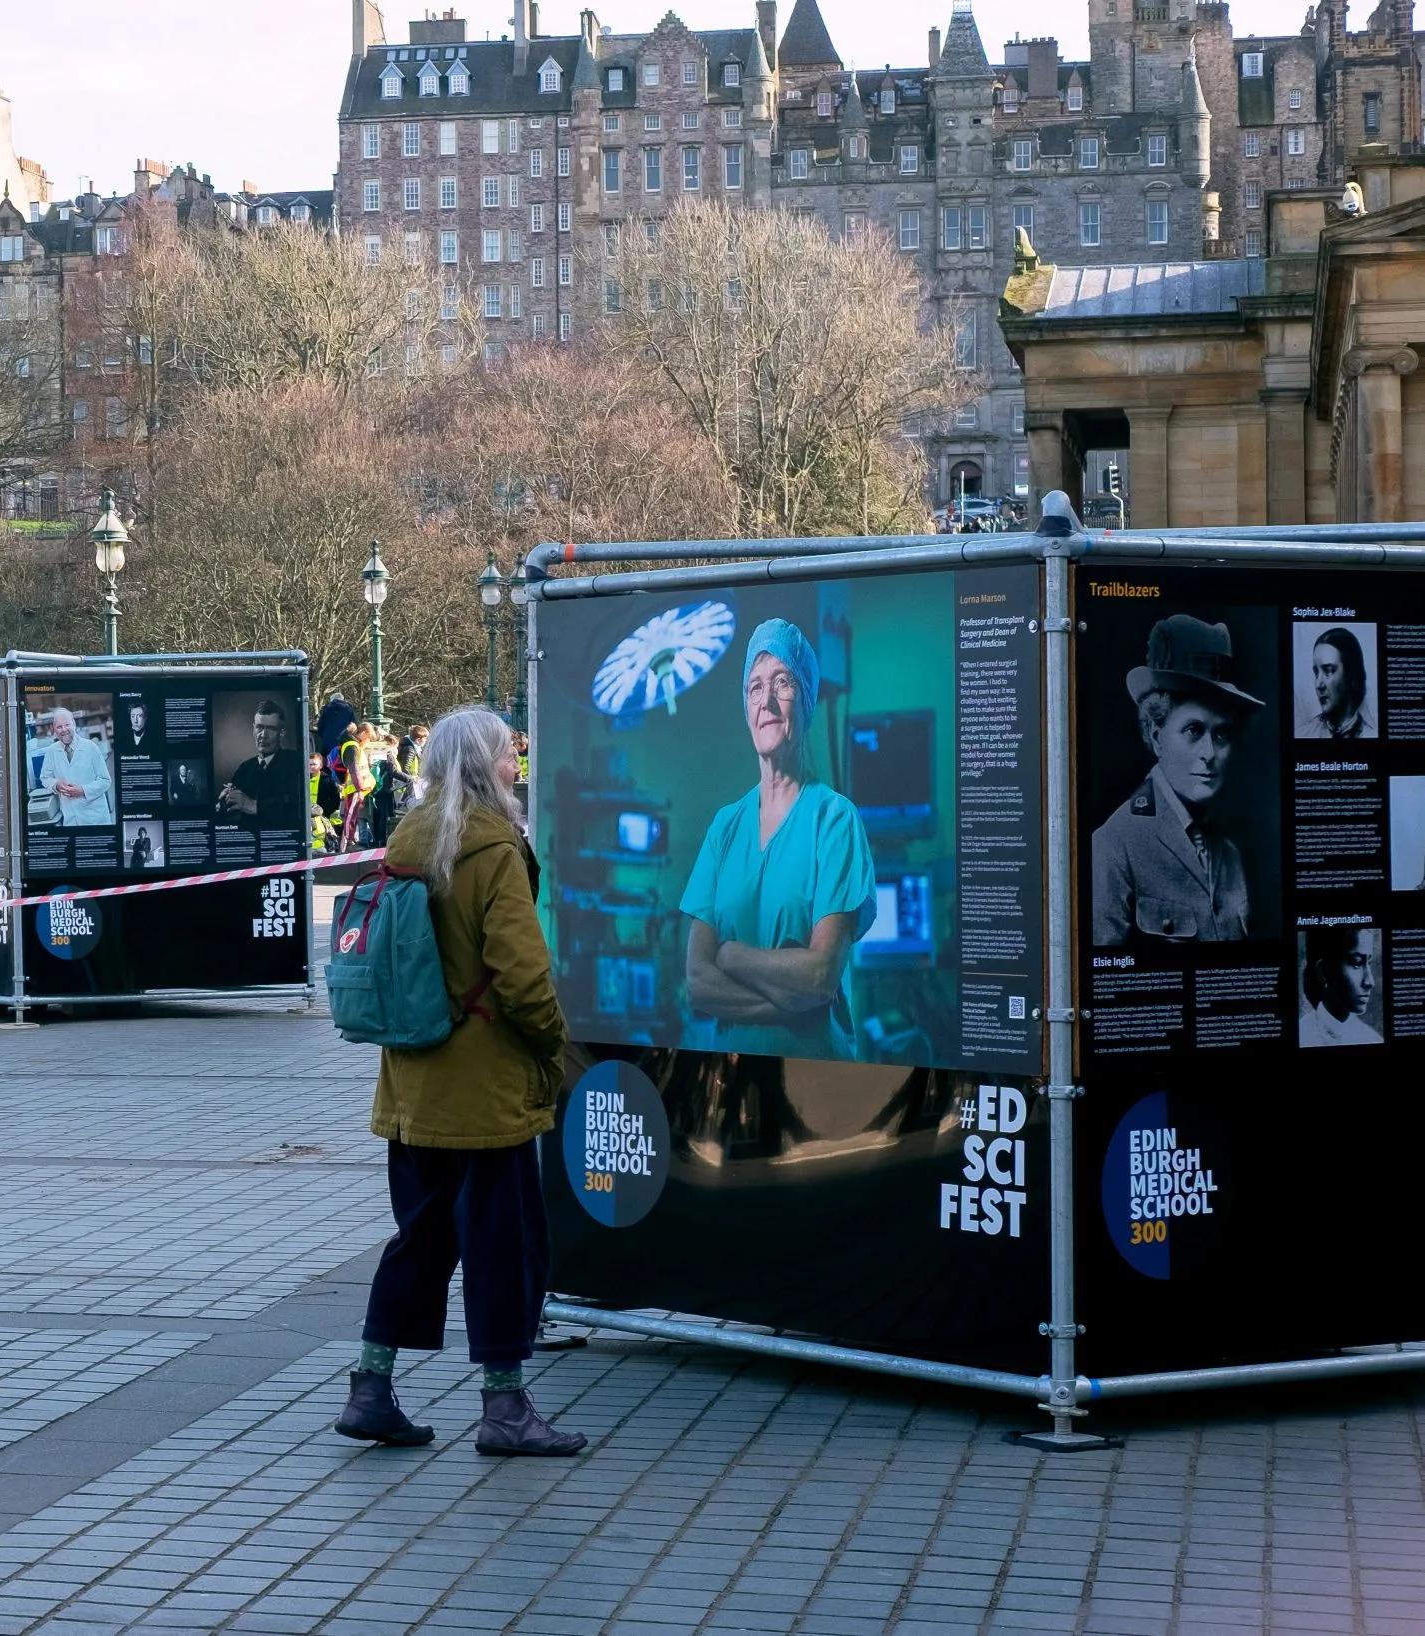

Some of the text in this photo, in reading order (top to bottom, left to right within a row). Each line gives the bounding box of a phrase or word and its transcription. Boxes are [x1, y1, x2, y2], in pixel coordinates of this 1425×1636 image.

[960, 594, 1006, 604] Lorna Marson
[1089, 582, 1159, 597] Trailblazers
[960, 616, 1024, 626] Professor of Transplant
[1293, 607, 1355, 618] Sophia Jex-Blake
[961, 627, 1017, 639] Surgery and Dean of
[961, 640, 980, 648] Clinical
[965, 725, 983, 733] surgeon
[1295, 762, 1368, 771] James Beale Horton
[261, 879, 295, 898] #ED
[50, 899, 73, 909] EDIN
[50, 908, 85, 918] BURGH
[263, 898, 294, 917] SCI
[51, 917, 94, 927] MEDICAL
[253, 918, 295, 937] FEST
[1297, 914, 1372, 927] Annie Jagannadham
[51, 925, 92, 936] SCHOOL
[51, 936, 70, 945] 300
[1093, 956, 1135, 968] Elsie Inglis
[586, 1090, 624, 1113] EDIN
[960, 1084, 1026, 1133] #ED
[586, 1111, 643, 1135] BURGH
[586, 1130, 656, 1156] MEDICAL
[1130, 1128, 1176, 1152] EDIN
[585, 1150, 651, 1176] SCHOOL
[963, 1134, 1025, 1186] SCI
[1130, 1148, 1200, 1175] BURGH
[585, 1171, 613, 1192] 300
[1131, 1170, 1218, 1197] MEDICAL
[940, 1183, 1026, 1238] FEST
[1130, 1192, 1213, 1220] SCHOOL
[1130, 1220, 1167, 1244] 300
